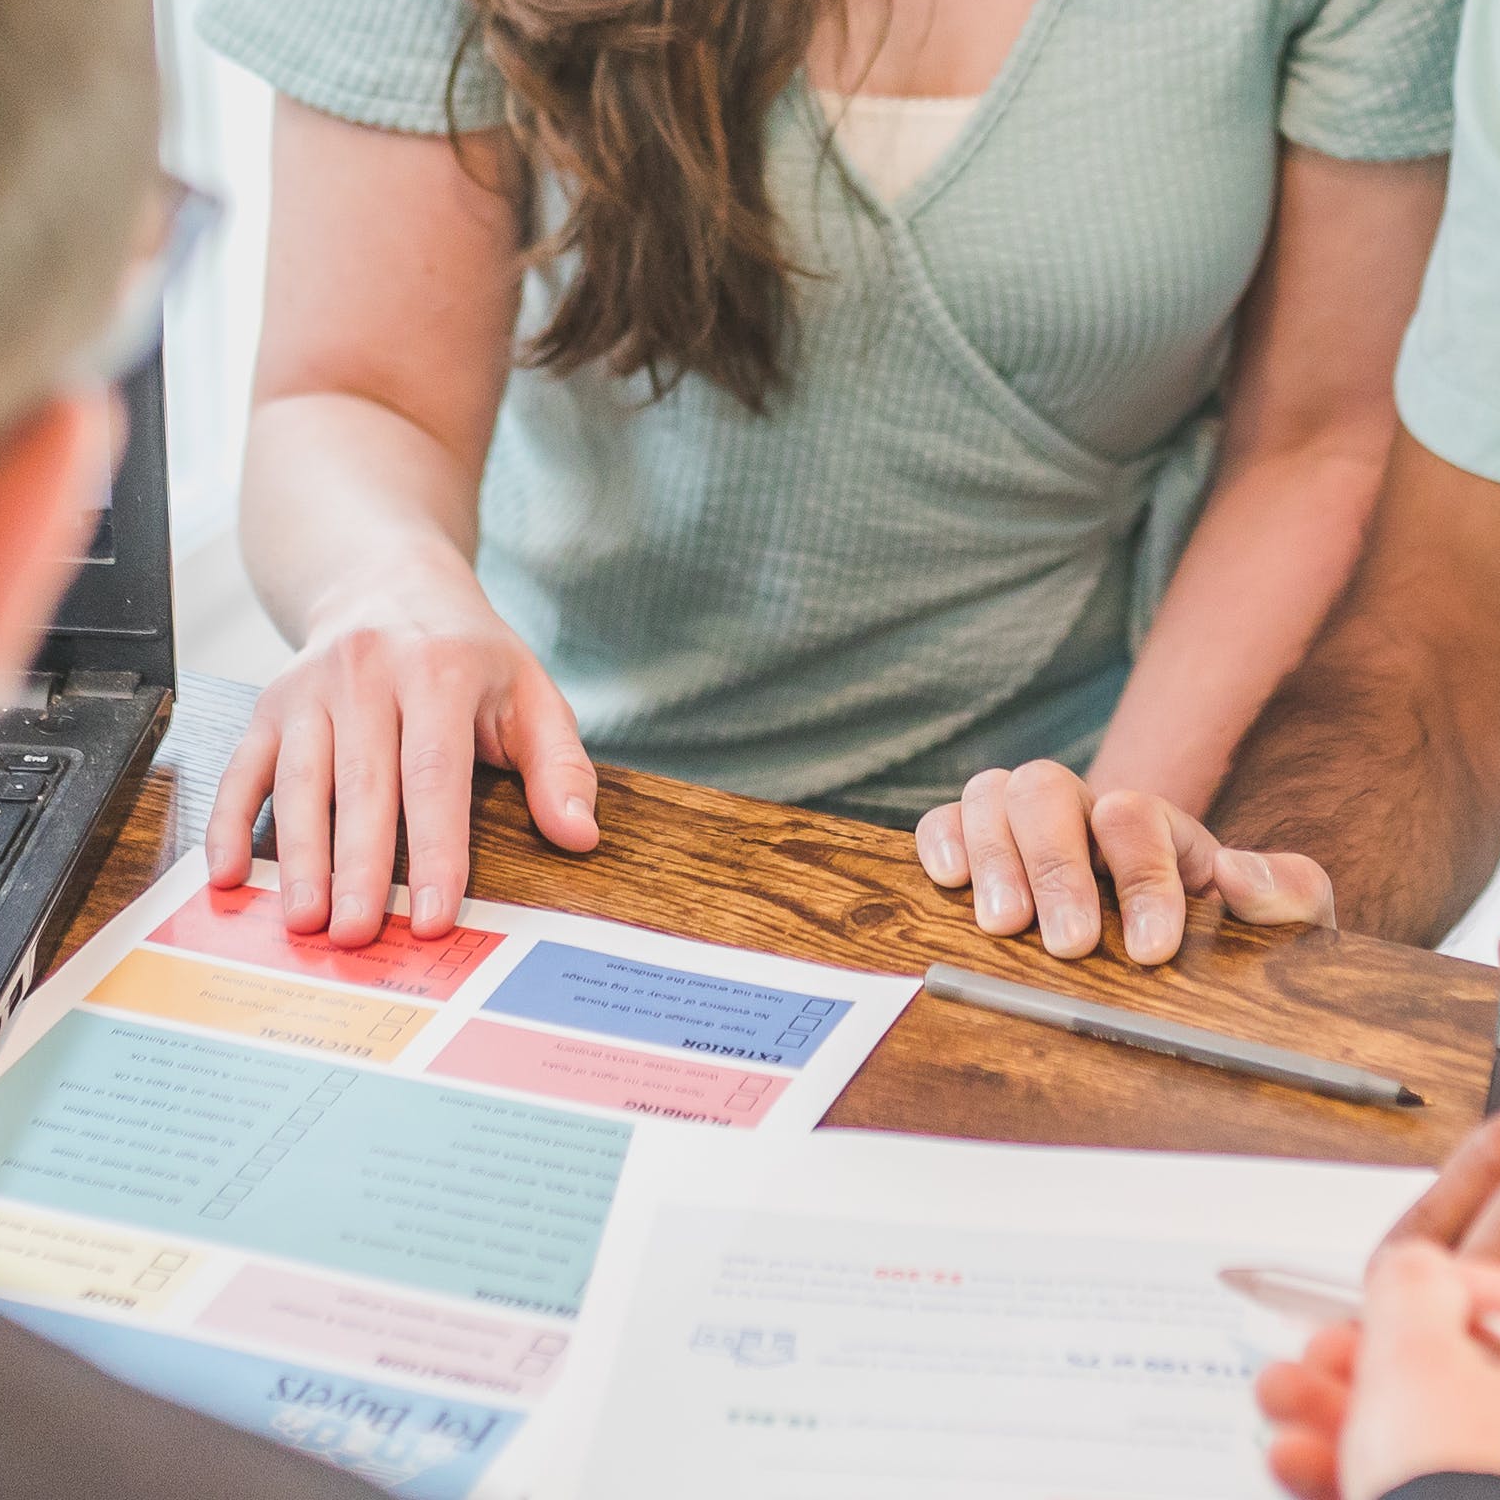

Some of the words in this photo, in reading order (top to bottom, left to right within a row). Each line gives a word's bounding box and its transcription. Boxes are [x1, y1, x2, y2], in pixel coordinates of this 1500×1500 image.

[23, 754, 49, 763] End
[606, 962, 665, 979] landscape
[374, 978, 429, 994] ATTIC
[562, 971, 610, 987] damage
[612, 981, 631, 991] big
[667, 974, 686, 984] the
[689, 980, 729, 992] eroded
[649, 989, 683, 1002] decay
[732, 988, 752, 997] not
[755, 993, 784, 1003] Have
[573, 996, 609, 1008] house
[612, 1002, 631, 1012] the
[683, 997, 697, 1005] of
[700, 1001, 751, 1016] evidence
[634, 1008, 662, 1018] from
[665, 1012, 717, 1029] drainage
[754, 1011, 771, 1020] No
[111, 1028, 169, 1046] functional
[259, 1027, 373, 1056] ELECTRICAL
[681, 1038, 784, 1063] EXTERIOR
[623, 1100, 732, 1126] PLUMBING
[79, 1289, 138, 1310] ROOF
[473, 1290, 581, 1319] INTERIOR
[267, 1372, 412, 1436] Buyers
[427, 1409, 501, 1453] For
